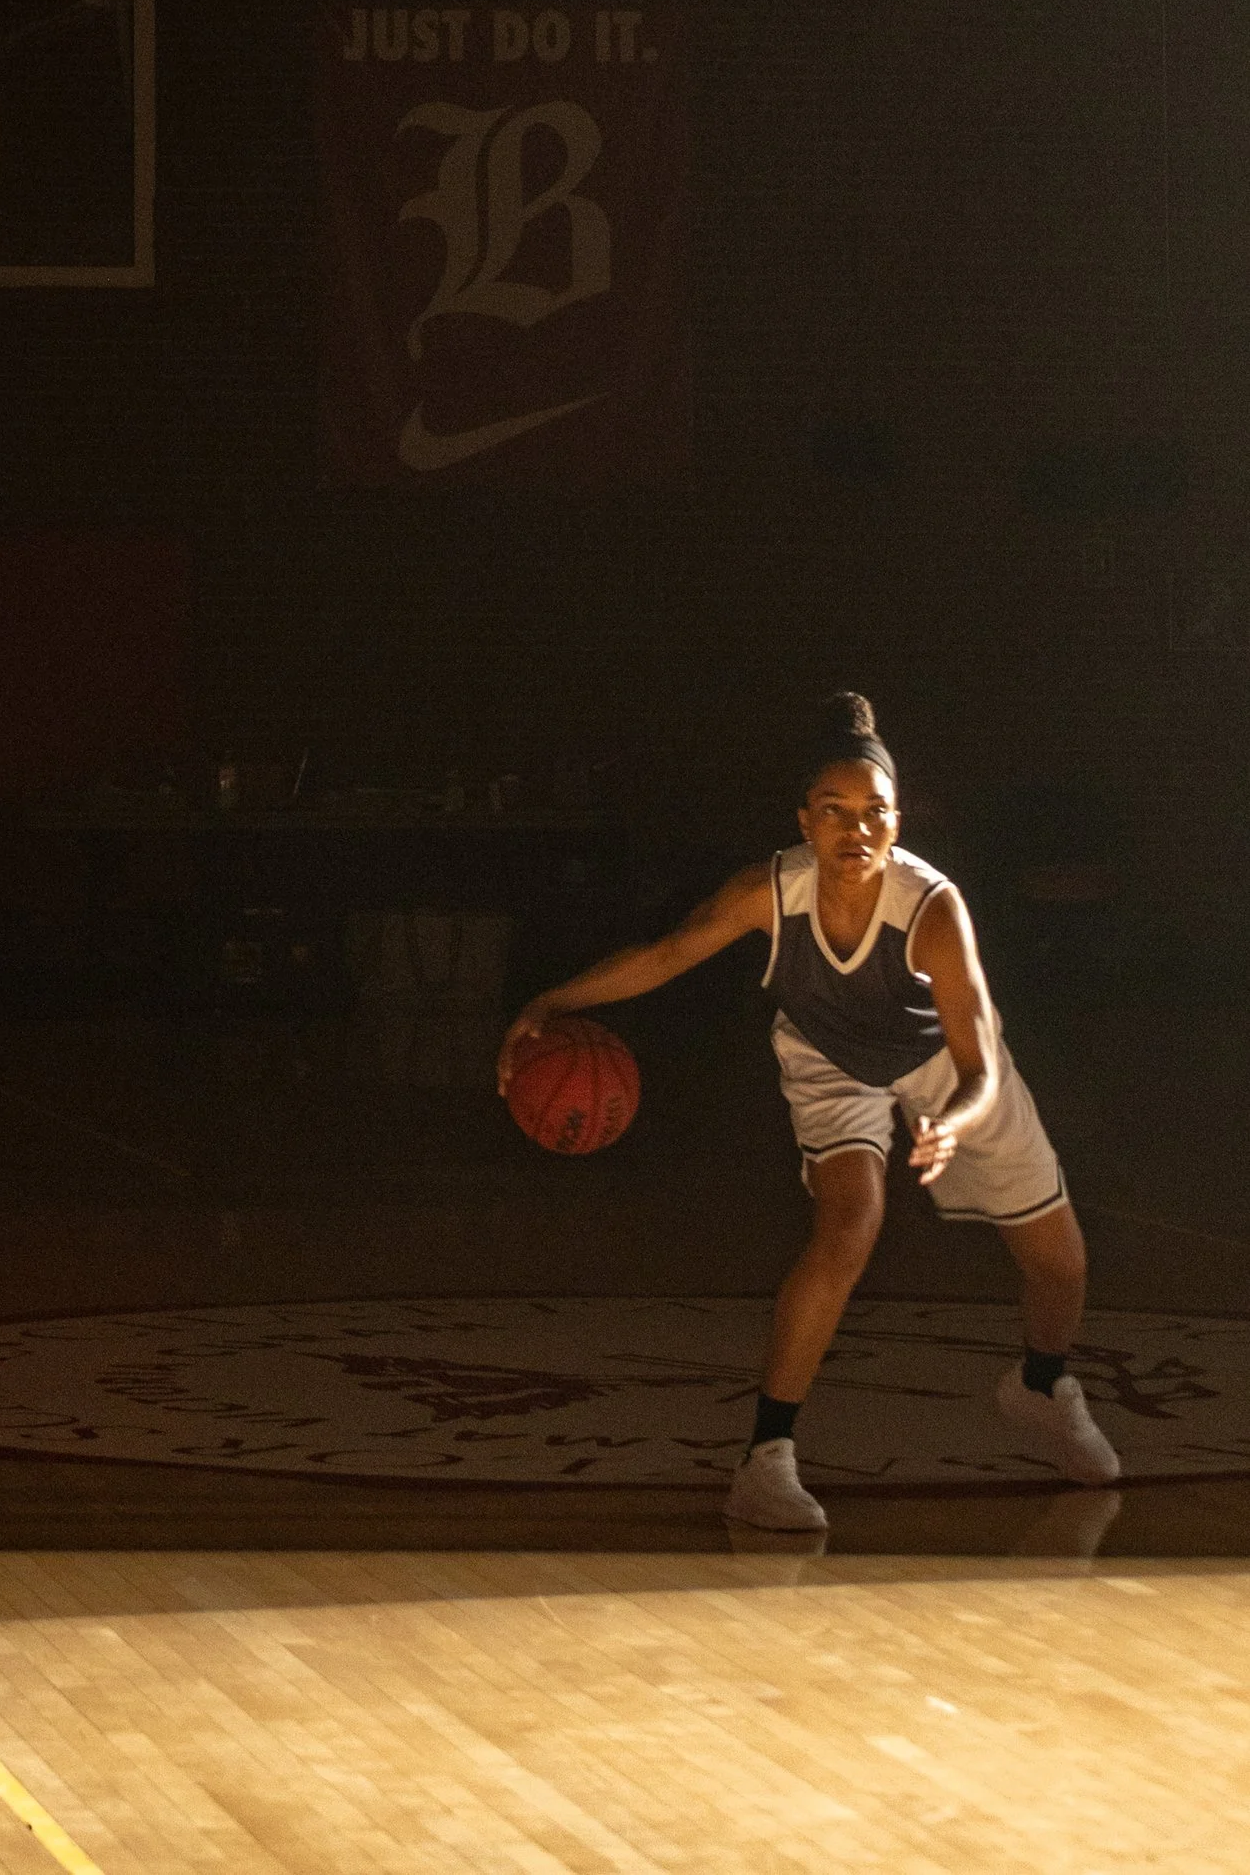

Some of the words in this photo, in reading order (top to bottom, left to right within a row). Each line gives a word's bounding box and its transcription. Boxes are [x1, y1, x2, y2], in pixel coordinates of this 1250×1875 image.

[343, 7, 471, 63] JUST
[493, 7, 571, 63] DO
[596, 10, 658, 63] IT.
[395, 100, 611, 361] B
